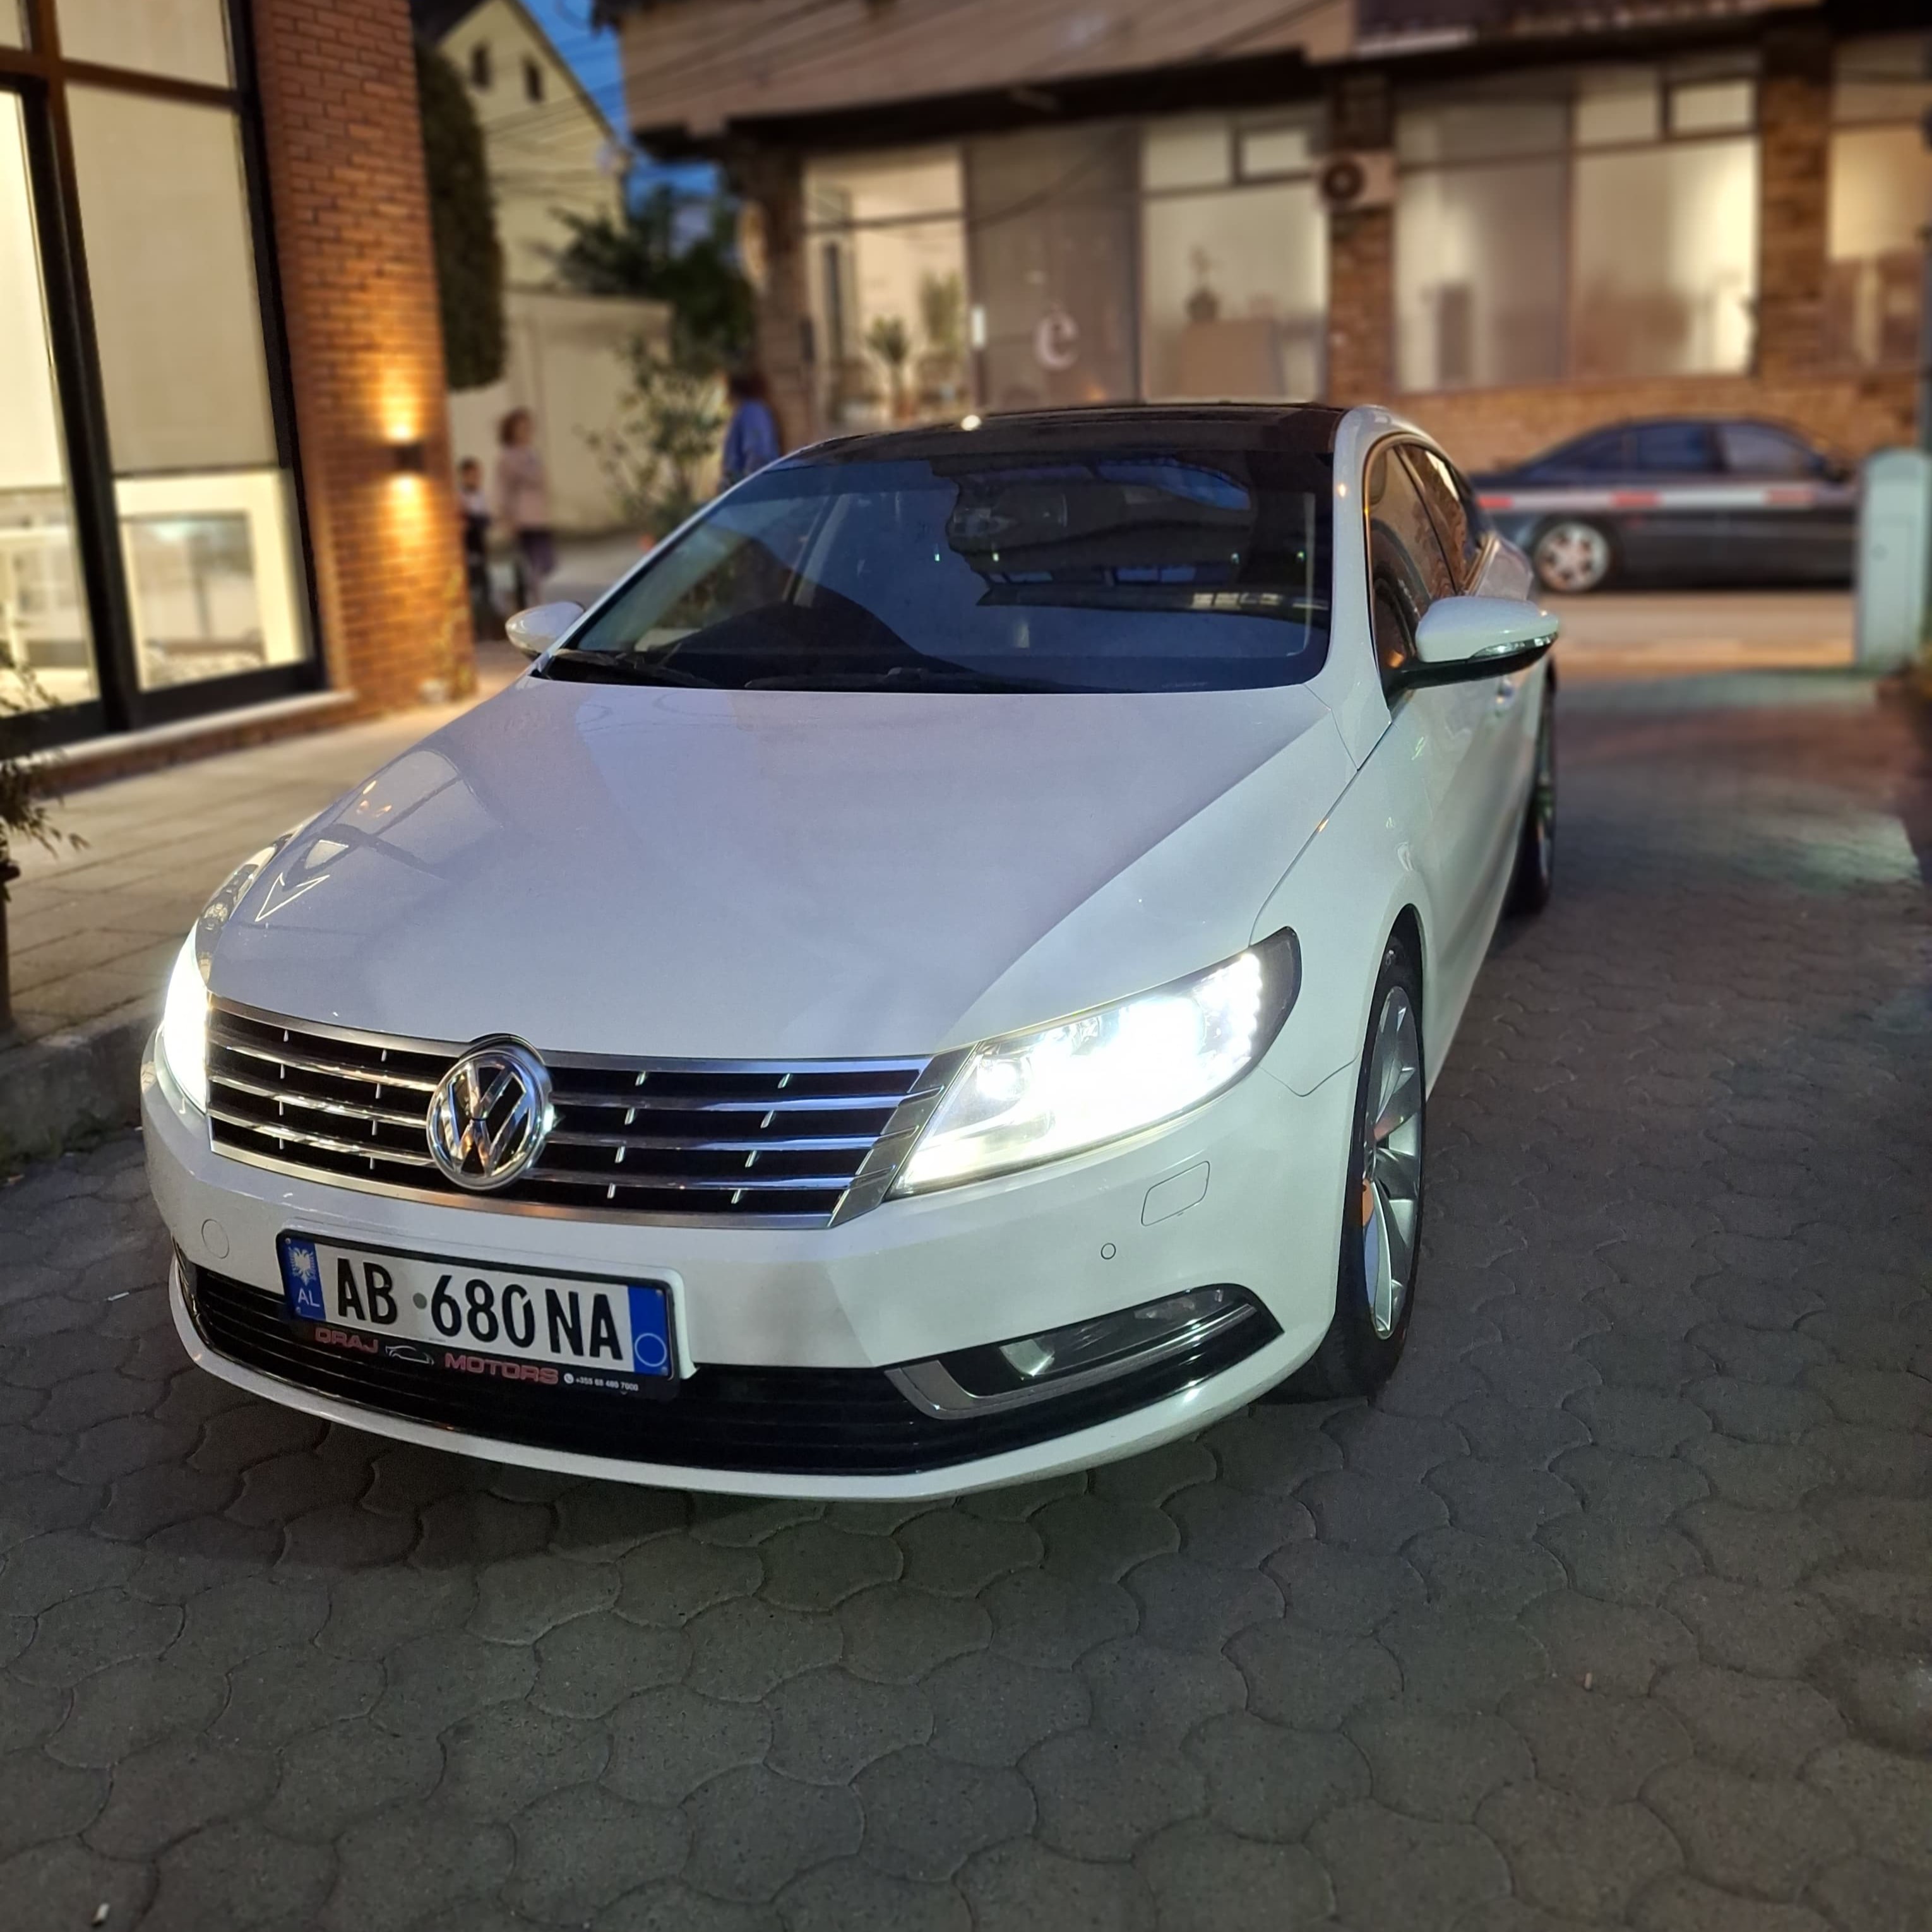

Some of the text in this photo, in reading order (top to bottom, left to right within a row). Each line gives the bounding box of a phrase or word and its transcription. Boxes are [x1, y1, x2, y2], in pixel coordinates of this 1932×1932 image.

[298, 1288, 320, 1308] AL
[337, 1257, 397, 1325] AB
[444, 1352, 558, 1384] MOTORS
